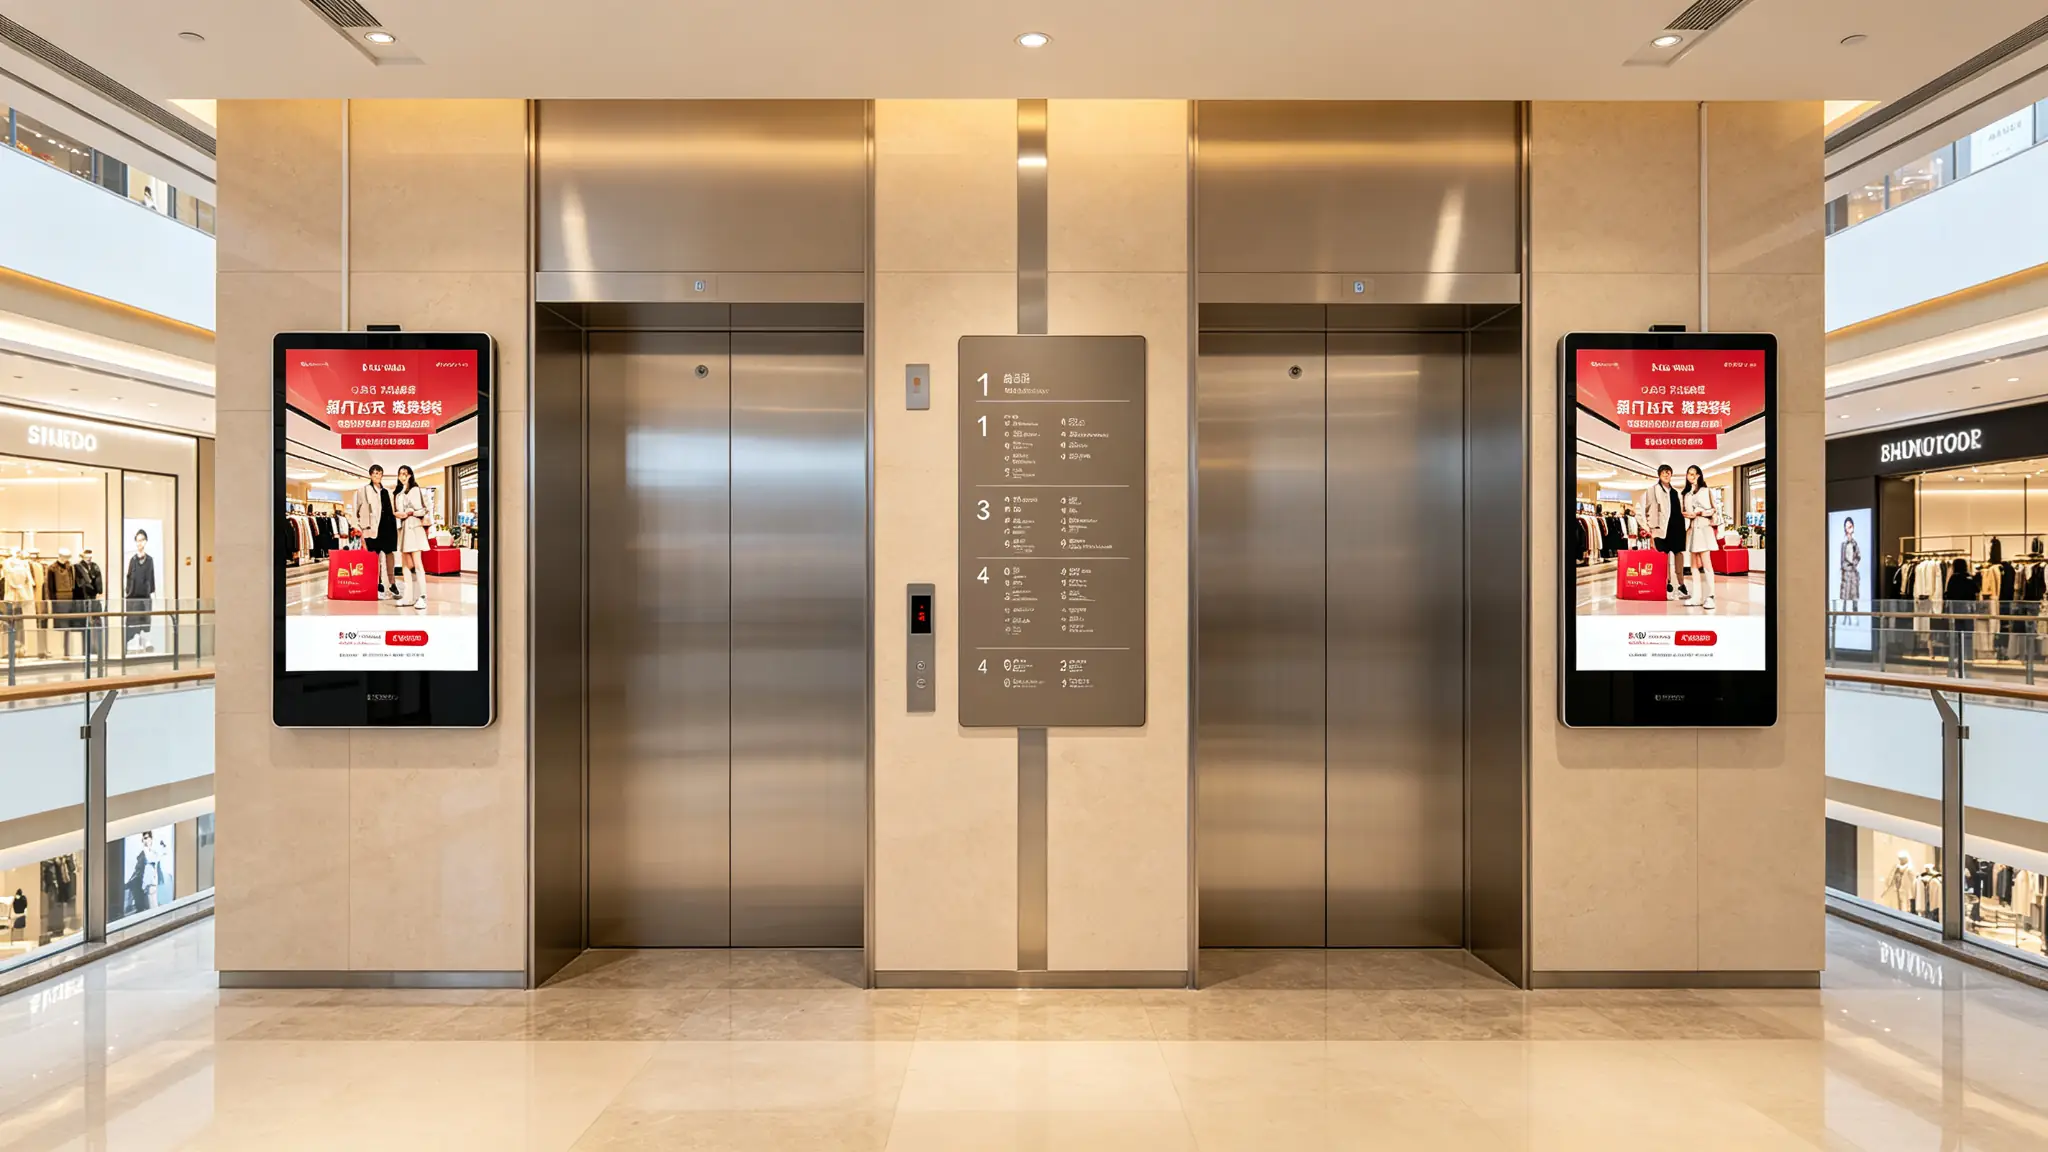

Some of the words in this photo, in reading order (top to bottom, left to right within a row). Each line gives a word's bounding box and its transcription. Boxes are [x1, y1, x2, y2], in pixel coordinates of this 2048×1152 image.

[977, 372, 989, 397] 1
[977, 415, 988, 437] 1
[976, 499, 991, 521] 3
[976, 566, 990, 585] 4
[977, 658, 989, 674] 4
